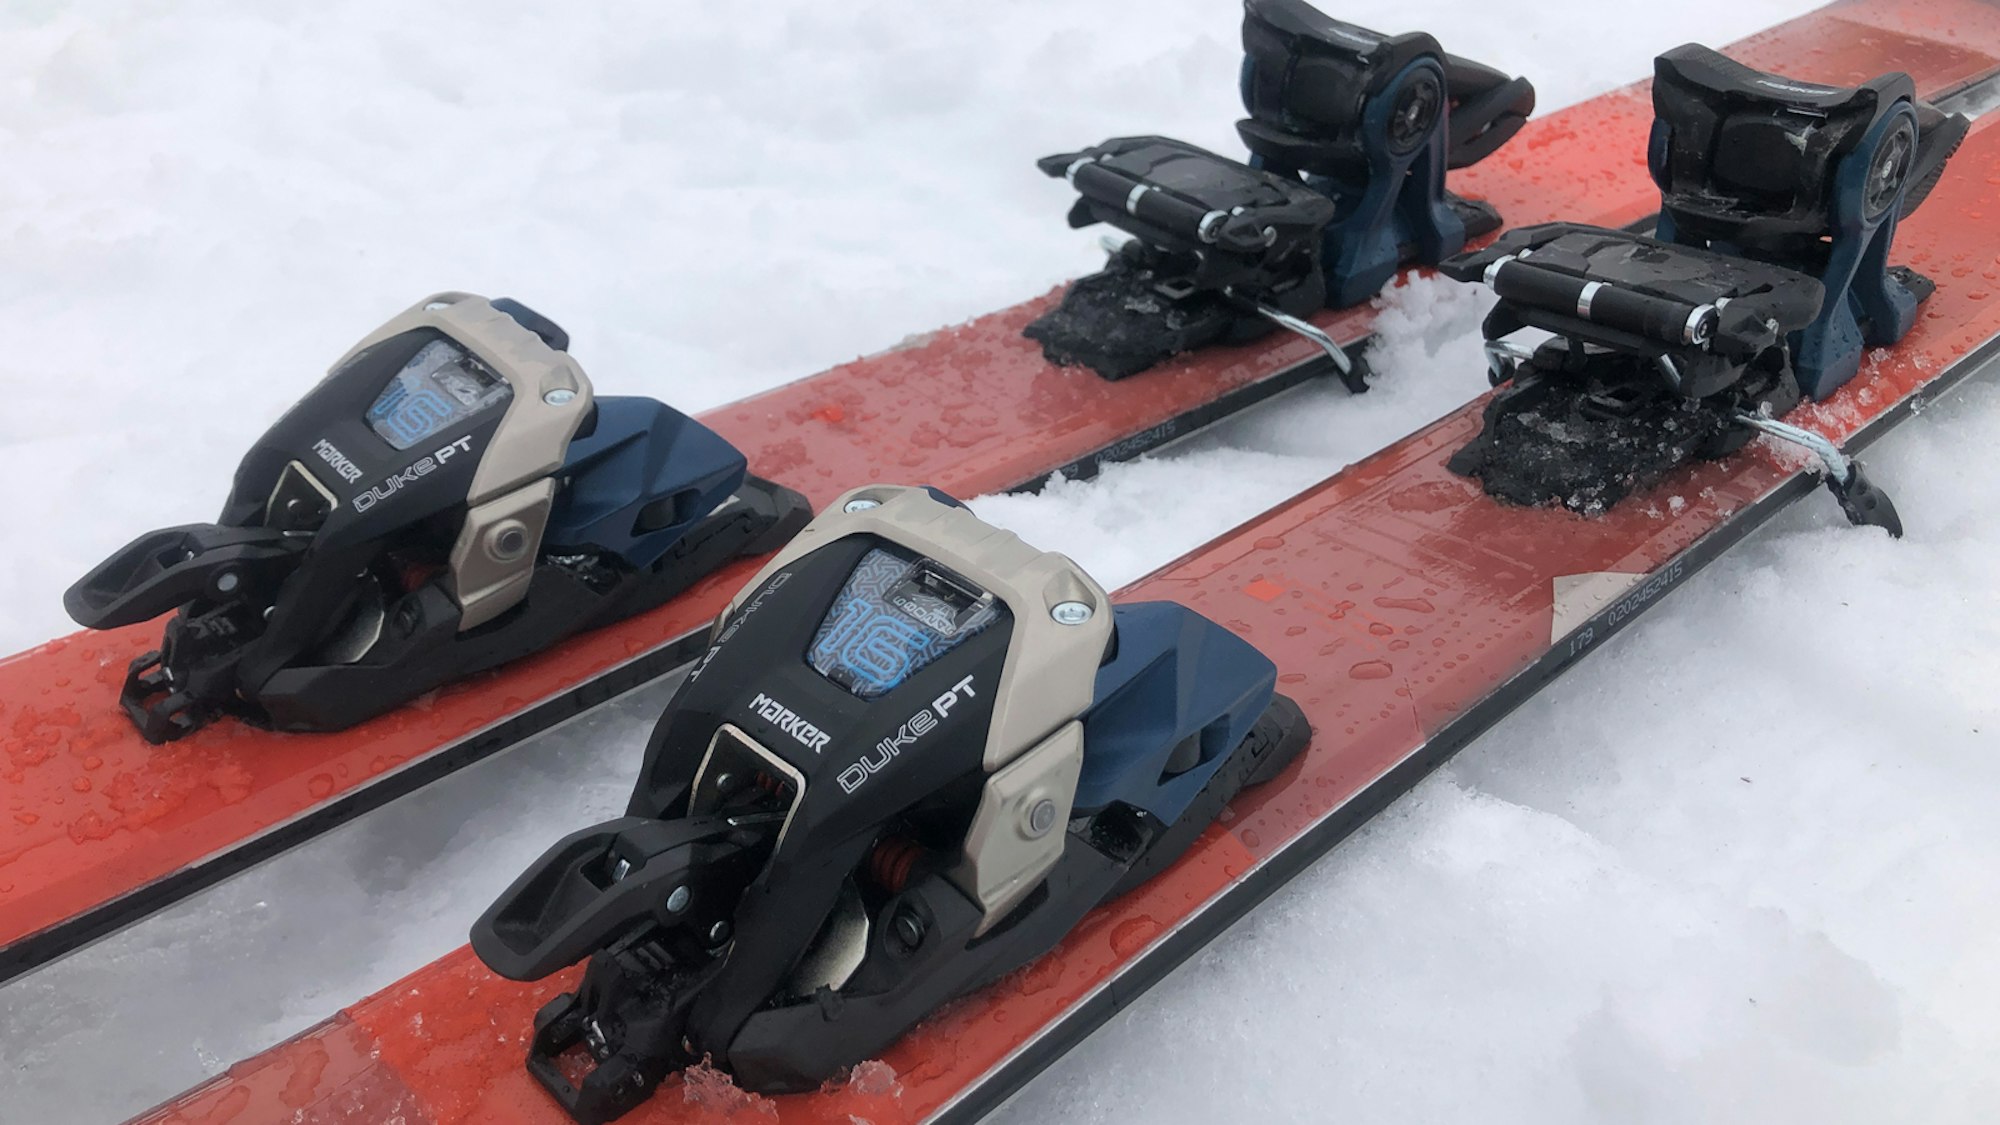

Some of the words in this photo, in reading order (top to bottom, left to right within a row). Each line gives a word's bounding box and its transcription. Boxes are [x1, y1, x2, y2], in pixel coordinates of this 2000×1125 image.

[312, 438, 363, 484] MARKER
[352, 456, 437, 513] DUKE
[434, 434, 472, 465] PT
[819, 597, 931, 690] 16
[1569, 626, 1594, 657] 179
[748, 692, 831, 754] MARKER
[836, 708, 938, 794] DUKE
[932, 674, 976, 718] PT
